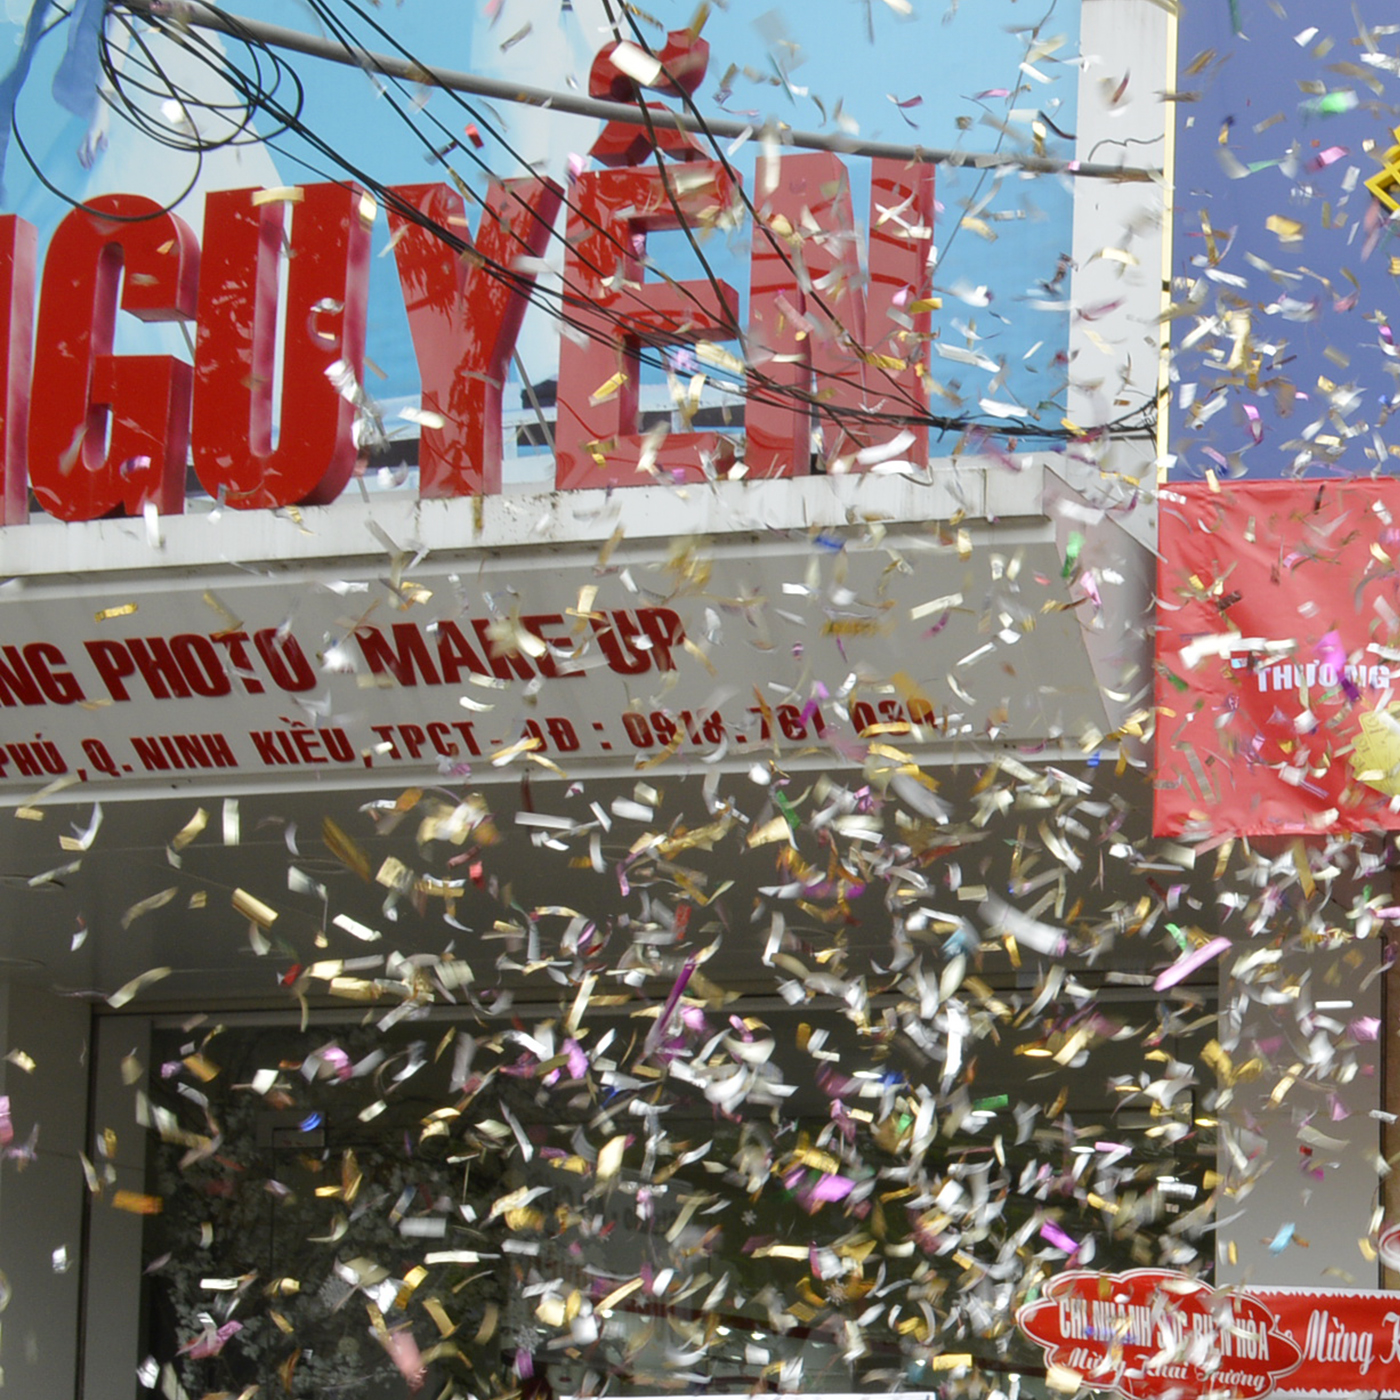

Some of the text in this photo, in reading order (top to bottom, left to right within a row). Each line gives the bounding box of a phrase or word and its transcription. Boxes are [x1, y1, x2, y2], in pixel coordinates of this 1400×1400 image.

[0, 28, 936, 525] GUYỄN
[84, 627, 317, 702] PHOTO
[597, 607, 687, 676] UP
[130, 732, 239, 771] NINH
[1058, 1296, 1088, 1340] CHI
[1236, 1310, 1270, 1361] HÒA
[1304, 1309, 1375, 1376] Mừng
